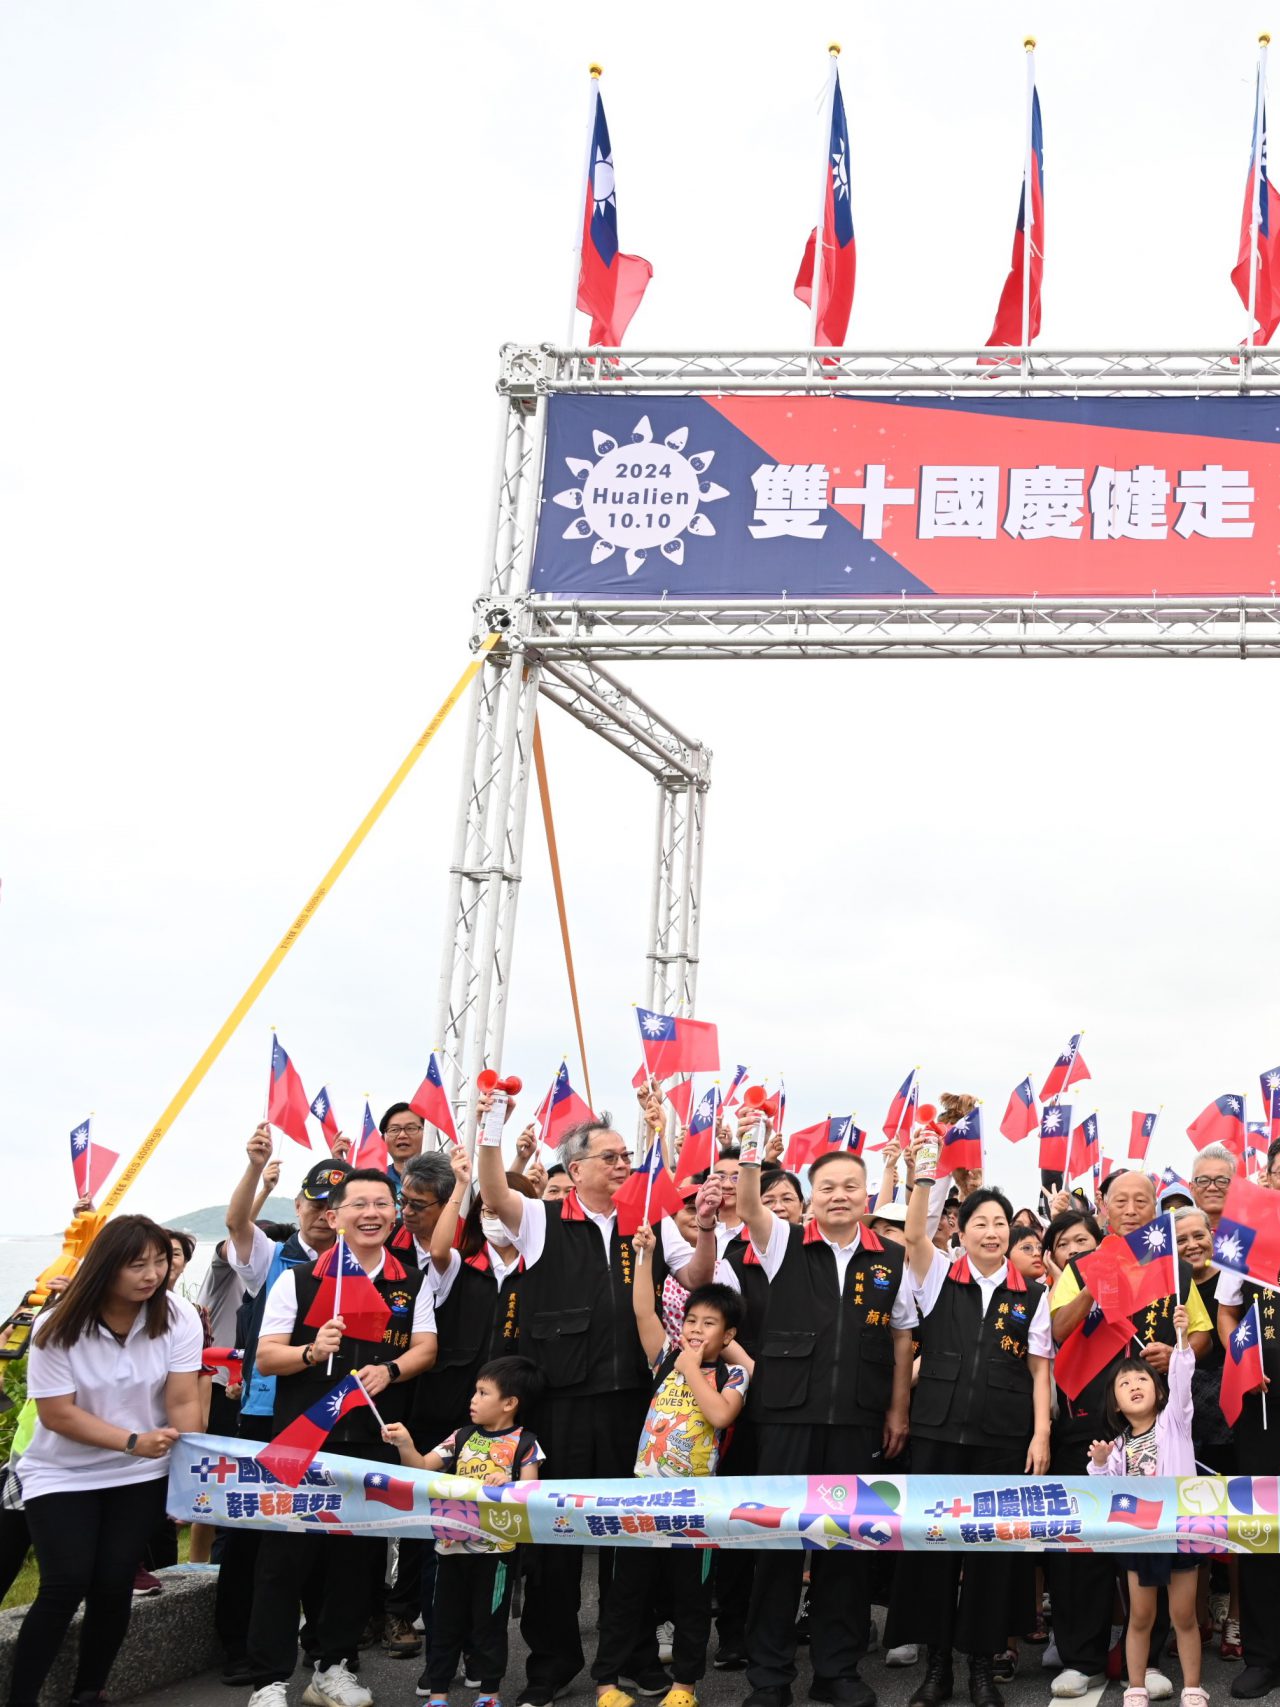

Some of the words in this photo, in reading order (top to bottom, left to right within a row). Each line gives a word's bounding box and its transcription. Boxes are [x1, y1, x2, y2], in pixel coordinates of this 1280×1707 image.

[616, 464, 672, 478] 2024
[592, 488, 689, 505] Hualien
[748, 464, 1255, 540] 雙十國慶健走
[608, 513, 671, 529] 10.10
[459, 1463, 487, 1475] ELMO
[960, 1519, 1082, 1544] 牽手毛孩齊步走
